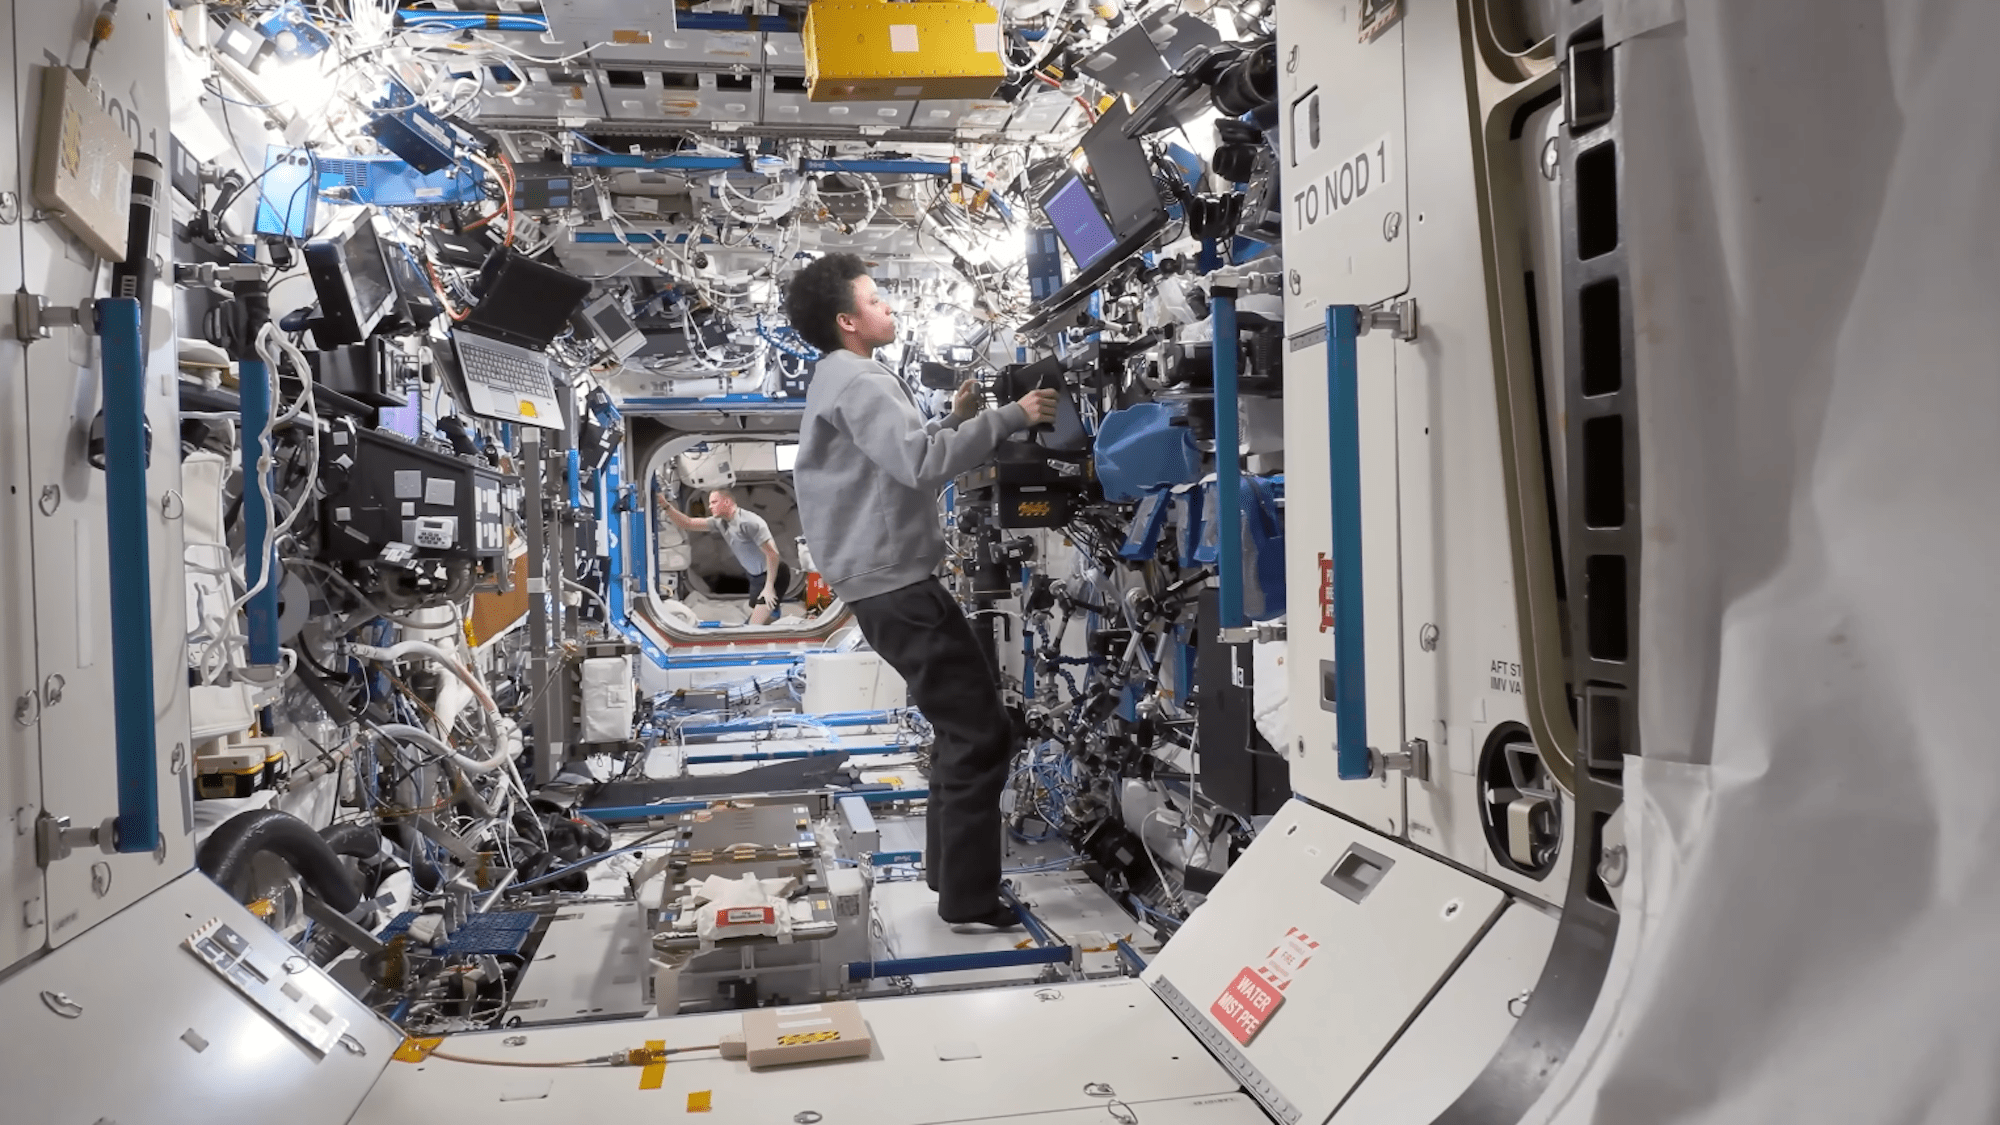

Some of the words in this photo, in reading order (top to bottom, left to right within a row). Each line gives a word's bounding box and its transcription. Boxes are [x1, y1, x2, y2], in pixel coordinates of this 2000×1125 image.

[149, 127, 156, 157] 1
[1294, 184, 1319, 231] TO
[1325, 152, 1369, 216] NOD
[1377, 140, 1385, 183] 1
[1491, 659, 1508, 675] AFT
[1280, 951, 1296, 966] FIRE
[1236, 975, 1272, 1012] WATER
[1217, 991, 1244, 1018] MIST
[1236, 1009, 1260, 1034] PFE
